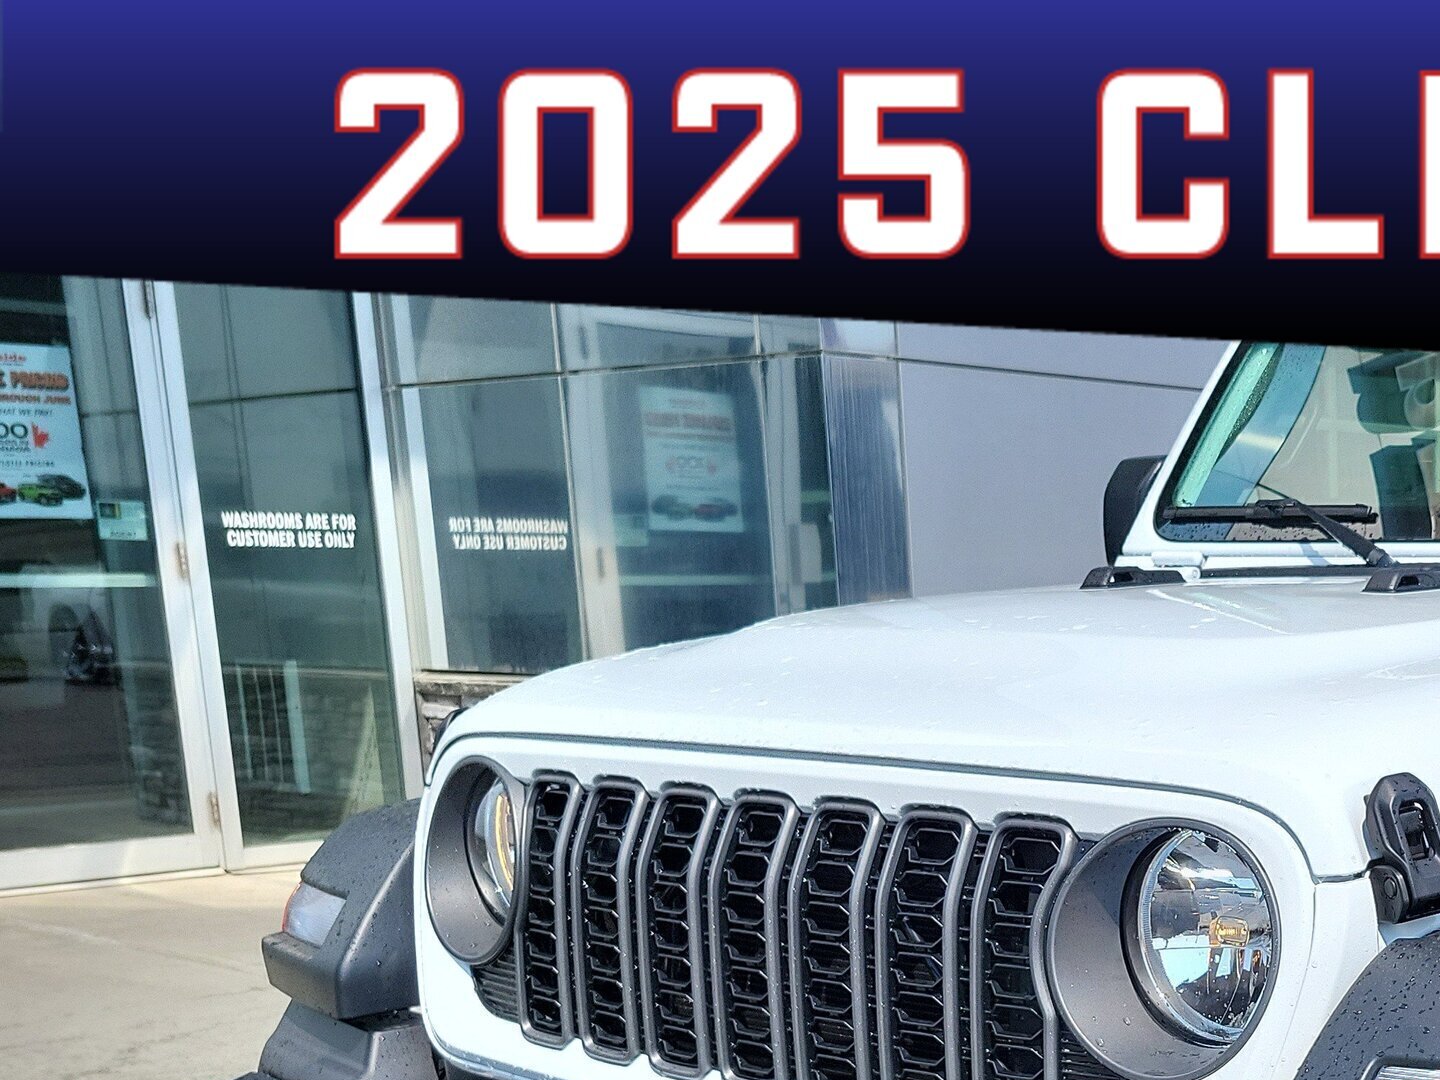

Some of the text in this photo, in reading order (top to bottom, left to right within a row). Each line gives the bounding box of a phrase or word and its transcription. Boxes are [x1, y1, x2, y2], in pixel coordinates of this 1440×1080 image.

[221, 511, 356, 530] WASHROOMS ARE FOR
[227, 529, 355, 548] CUSTOMER USE ONLY
